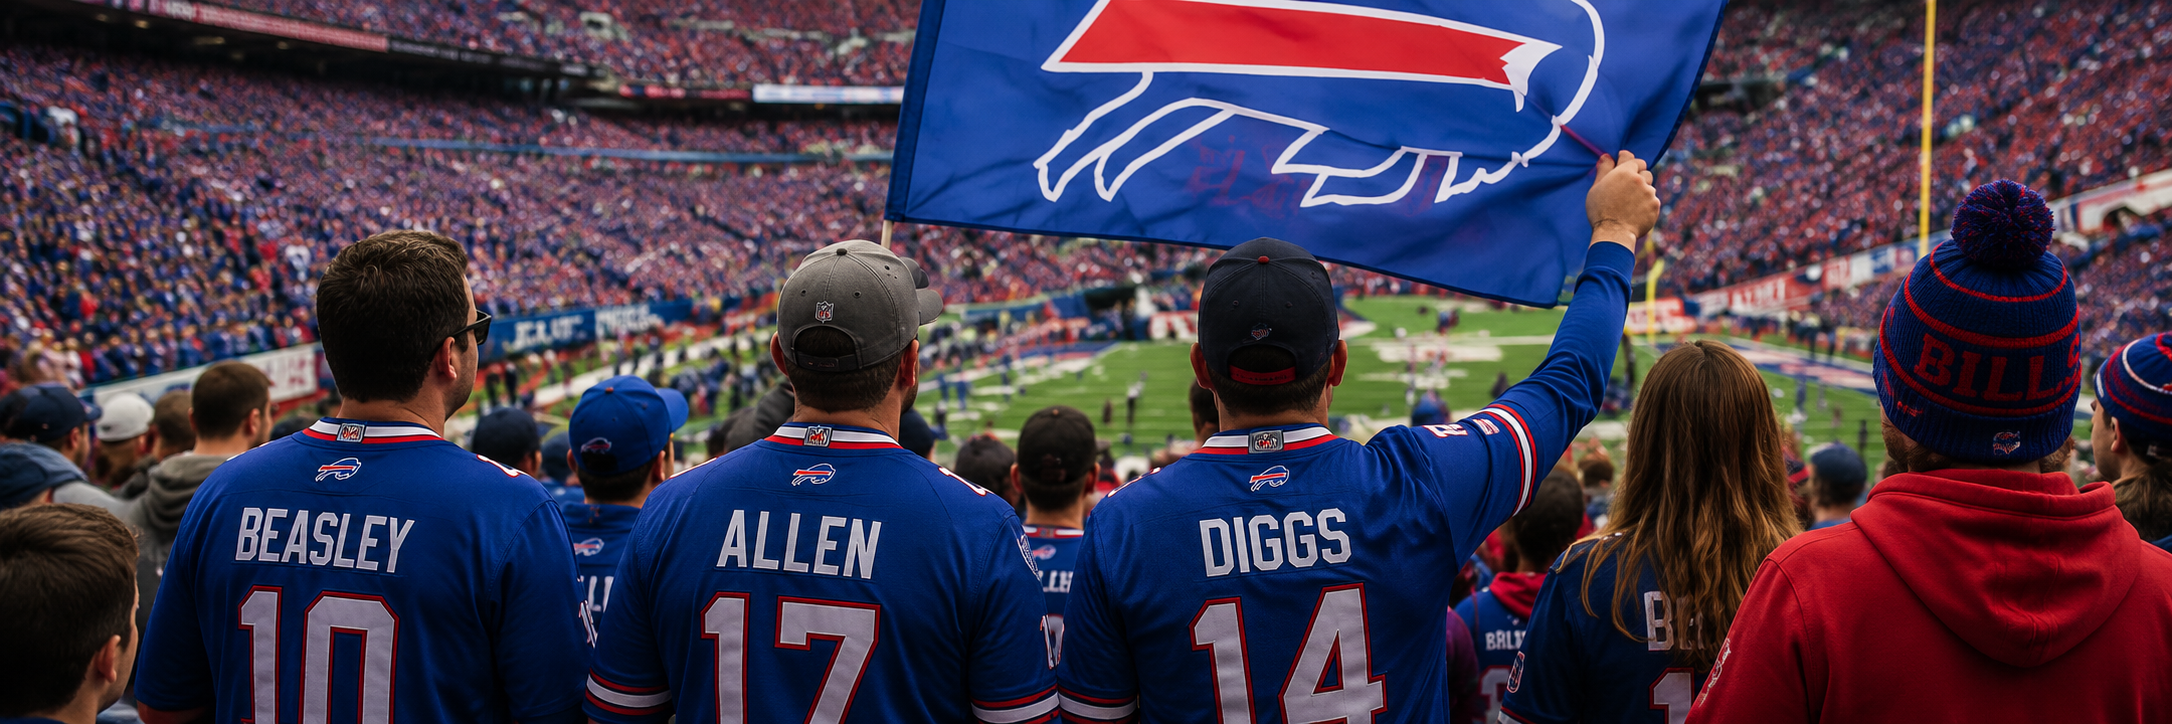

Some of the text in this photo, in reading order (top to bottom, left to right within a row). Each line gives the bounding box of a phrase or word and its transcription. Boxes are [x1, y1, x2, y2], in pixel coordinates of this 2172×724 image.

[235, 507, 416, 573] BEASLEY
[716, 509, 882, 580] ALLEN
[1199, 507, 1352, 578] DIGGS
[237, 584, 400, 724] 10
[700, 591, 881, 724] 17
[1188, 582, 1388, 724] 14
